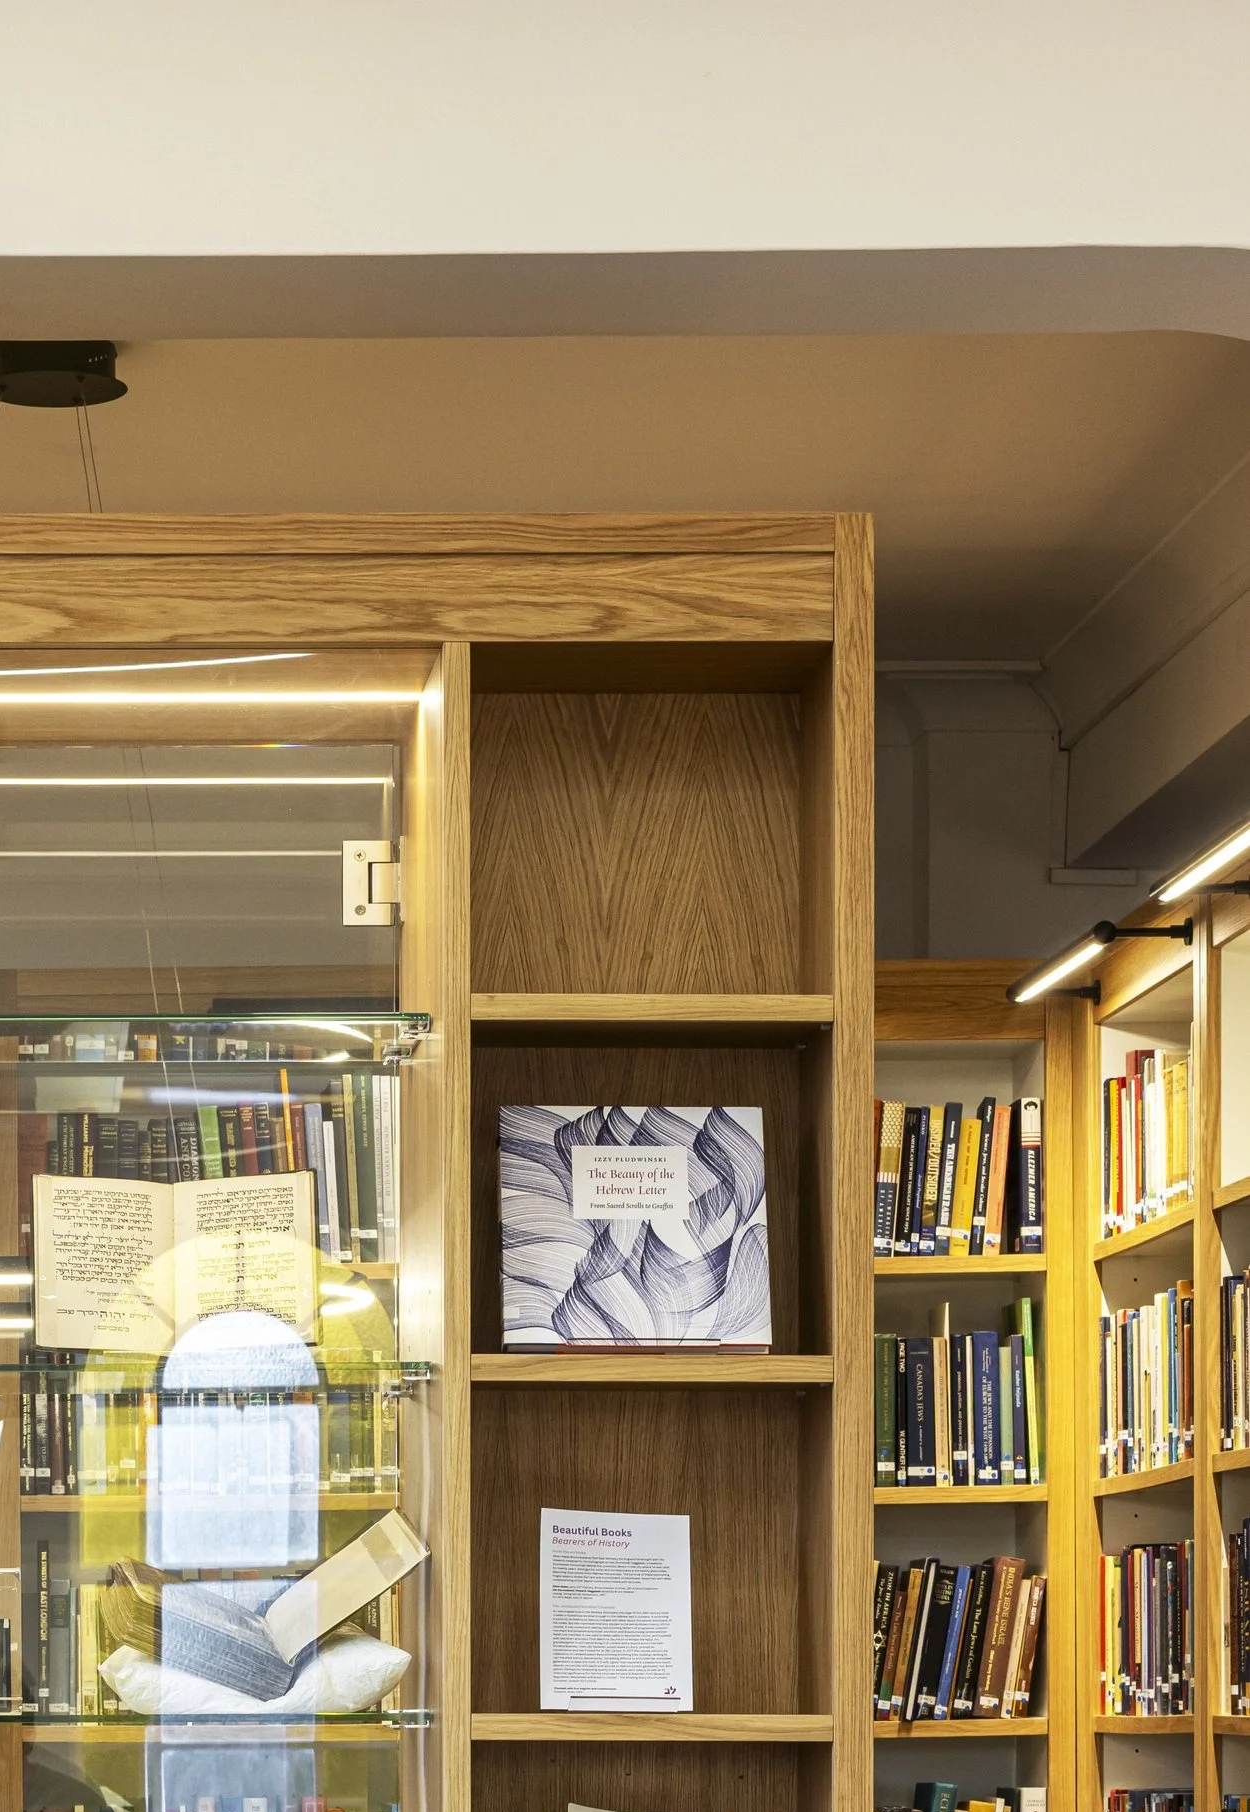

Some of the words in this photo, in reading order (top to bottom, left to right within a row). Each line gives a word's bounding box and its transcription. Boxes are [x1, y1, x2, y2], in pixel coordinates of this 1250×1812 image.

[181, 1138, 190, 1161] AND
[587, 1168, 607, 1179] The
[610, 1168, 644, 1182] Beauty
[647, 1167, 659, 1182] of
[660, 1169, 675, 1179] the
[1027, 1150, 1035, 1185] KLEZMER
[596, 1184, 635, 1195] Hebrew
[638, 1185, 667, 1195] Letter
[652, 1202, 674, 1211] Graffiti
[1027, 1186, 1036, 1221] AMERICA
[916, 1400, 924, 1422] JEWS
[552, 1525, 599, 1536] Beautiful
[601, 1528, 632, 1537] Books
[552, 1537, 585, 1546] Bearers
[587, 1538, 596, 1546] of
[598, 1539, 630, 1549] History
[886, 1588, 891, 1596] IN
[880, 1597, 889, 1629] AFRICA
[1002, 1598, 1011, 1617] BENE
[998, 1617, 1008, 1646] ISRAEL
